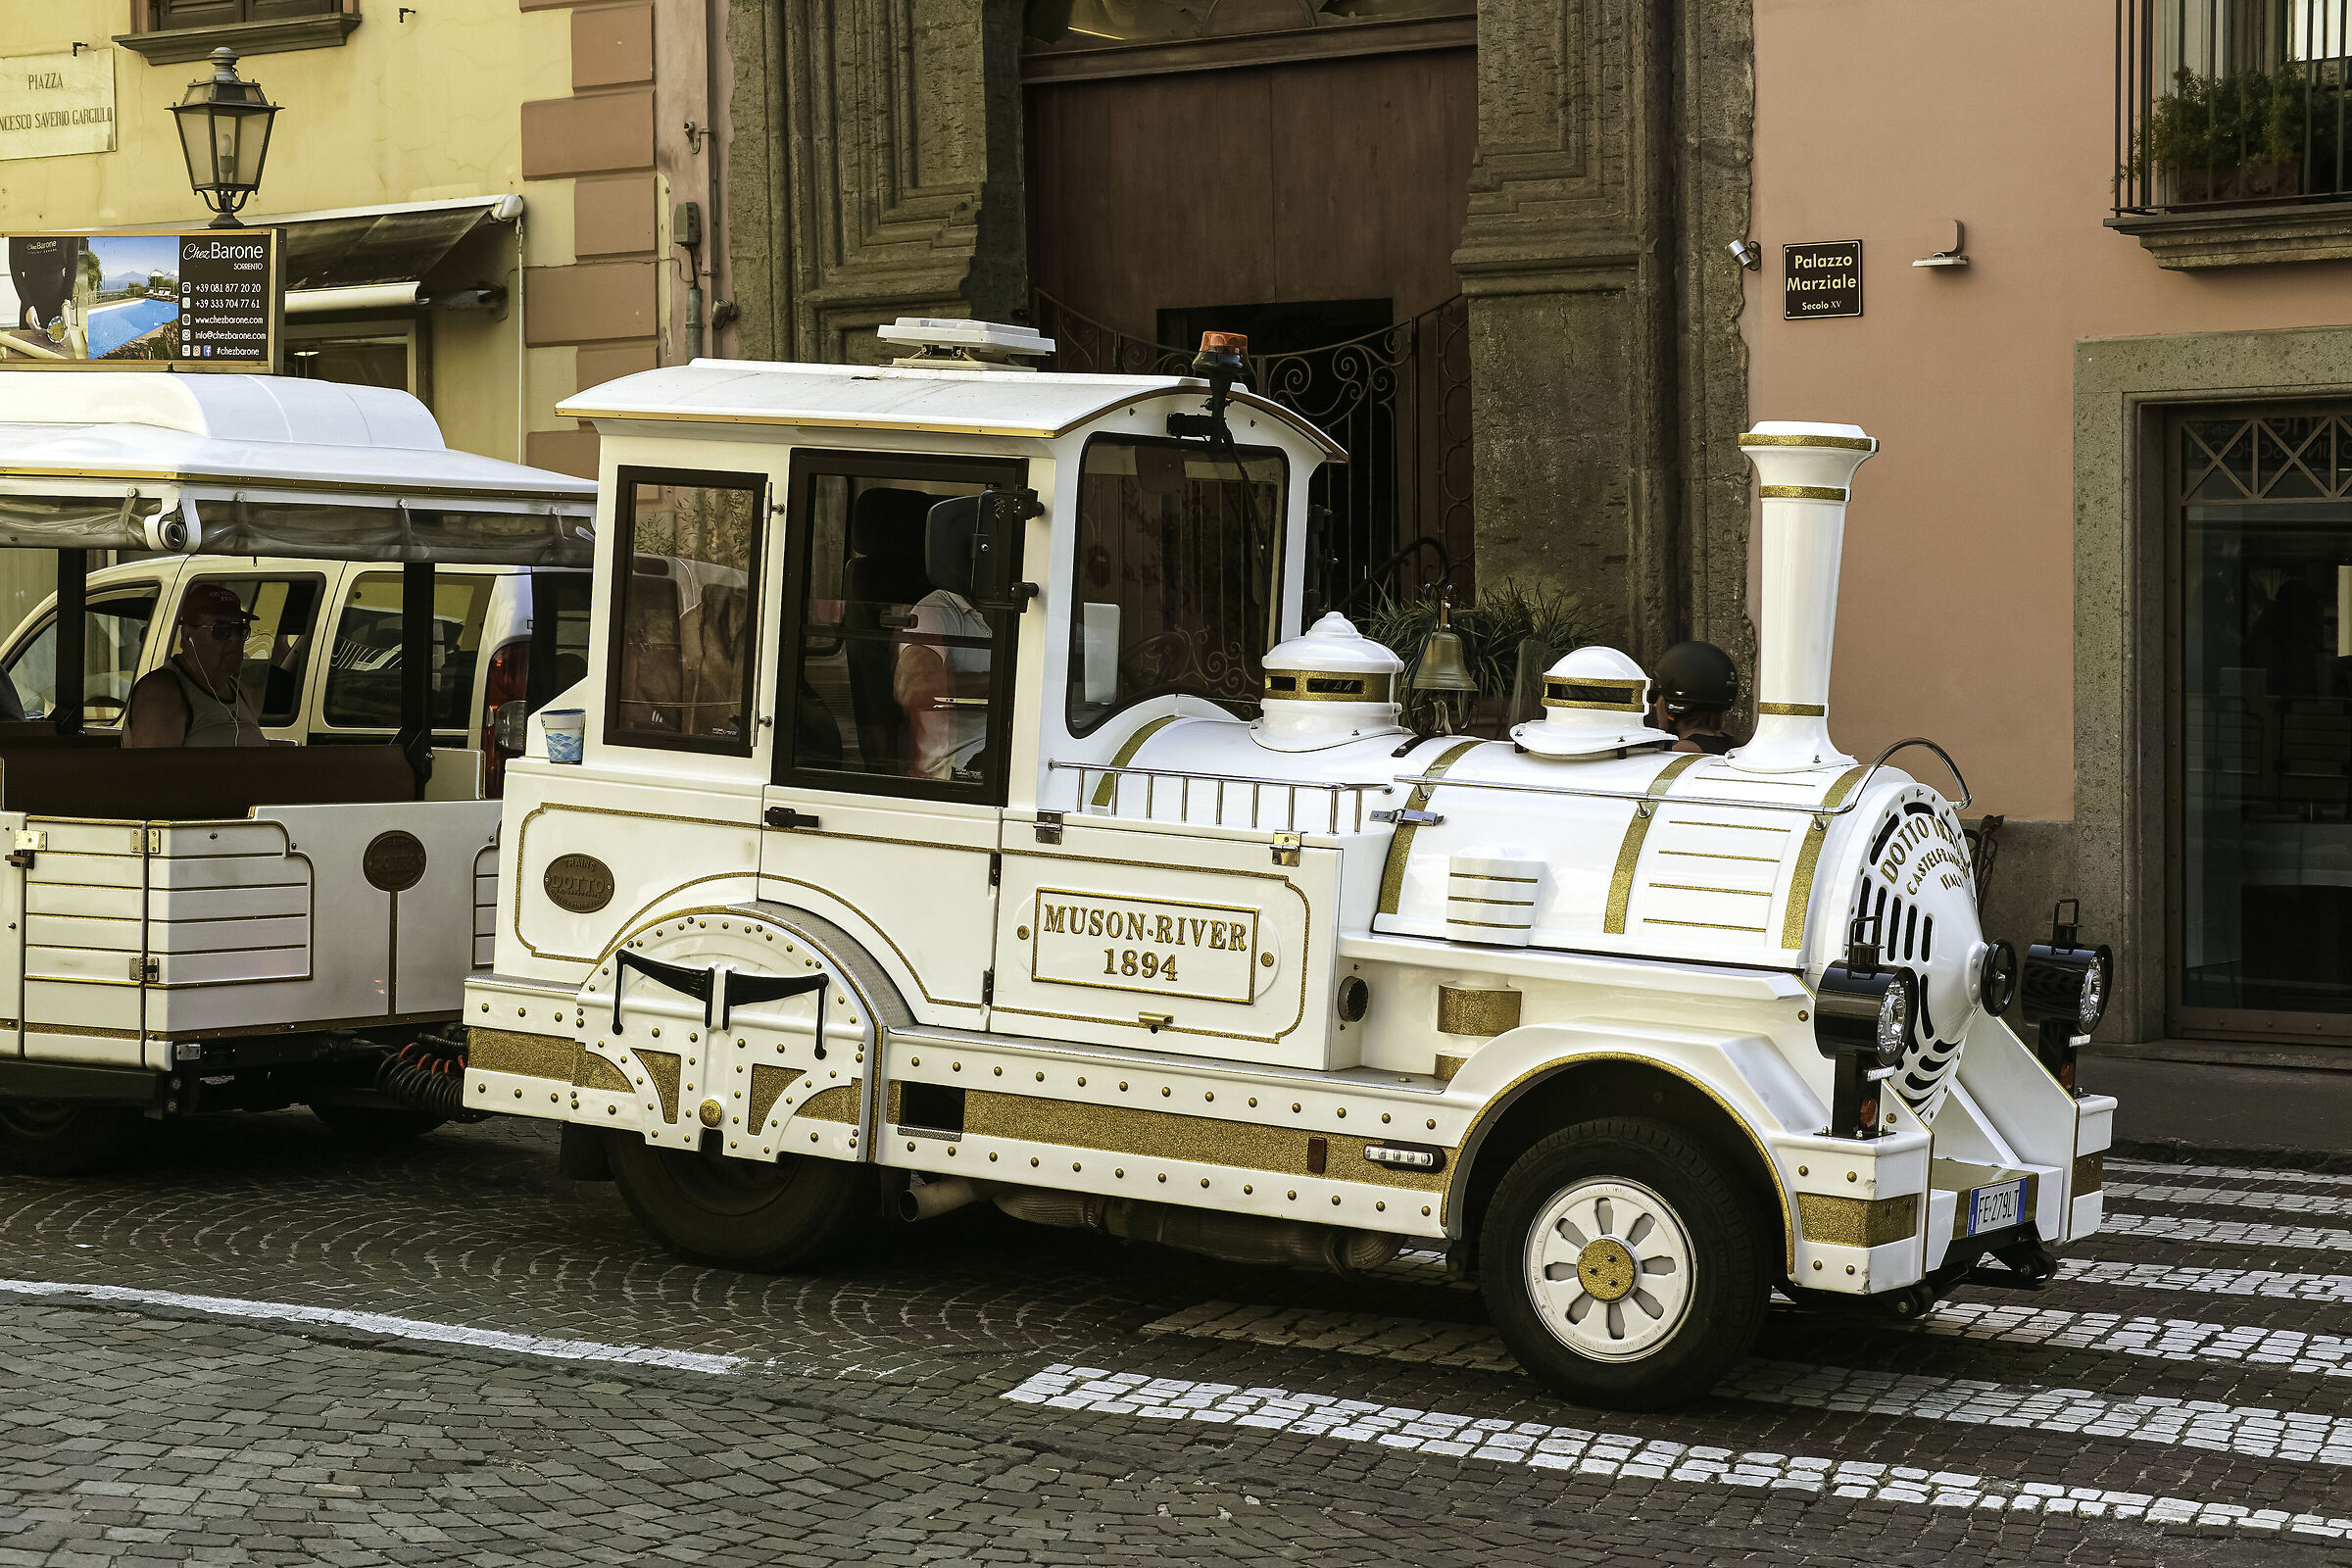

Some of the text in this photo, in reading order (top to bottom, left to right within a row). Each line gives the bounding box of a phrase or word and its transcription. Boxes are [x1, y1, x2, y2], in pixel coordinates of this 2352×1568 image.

[27, 73, 64, 90] PIAZZA
[34, 110, 70, 128] SAVERIO
[72, 106, 113, 125] GARGIULO
[182, 241, 264, 261] Chez Barone
[1794, 253, 1853, 270] Palazzo
[195, 283, 262, 293] +39 081 877 20 20
[1787, 273, 1857, 292] Marziale
[195, 299, 261, 309] +39 333 704 77 61
[1801, 300, 1842, 311] Secolo XV
[194, 315, 264, 324] www.chezbarone.com
[195, 330, 267, 340] info@chezbarone.com
[216, 347, 260, 356] #chezbarone
[1880, 815, 1930, 885] DOTTO
[564, 858, 597, 872] TRAINS
[552, 874, 606, 894] DOTTO
[1103, 948, 1179, 981] 1894
